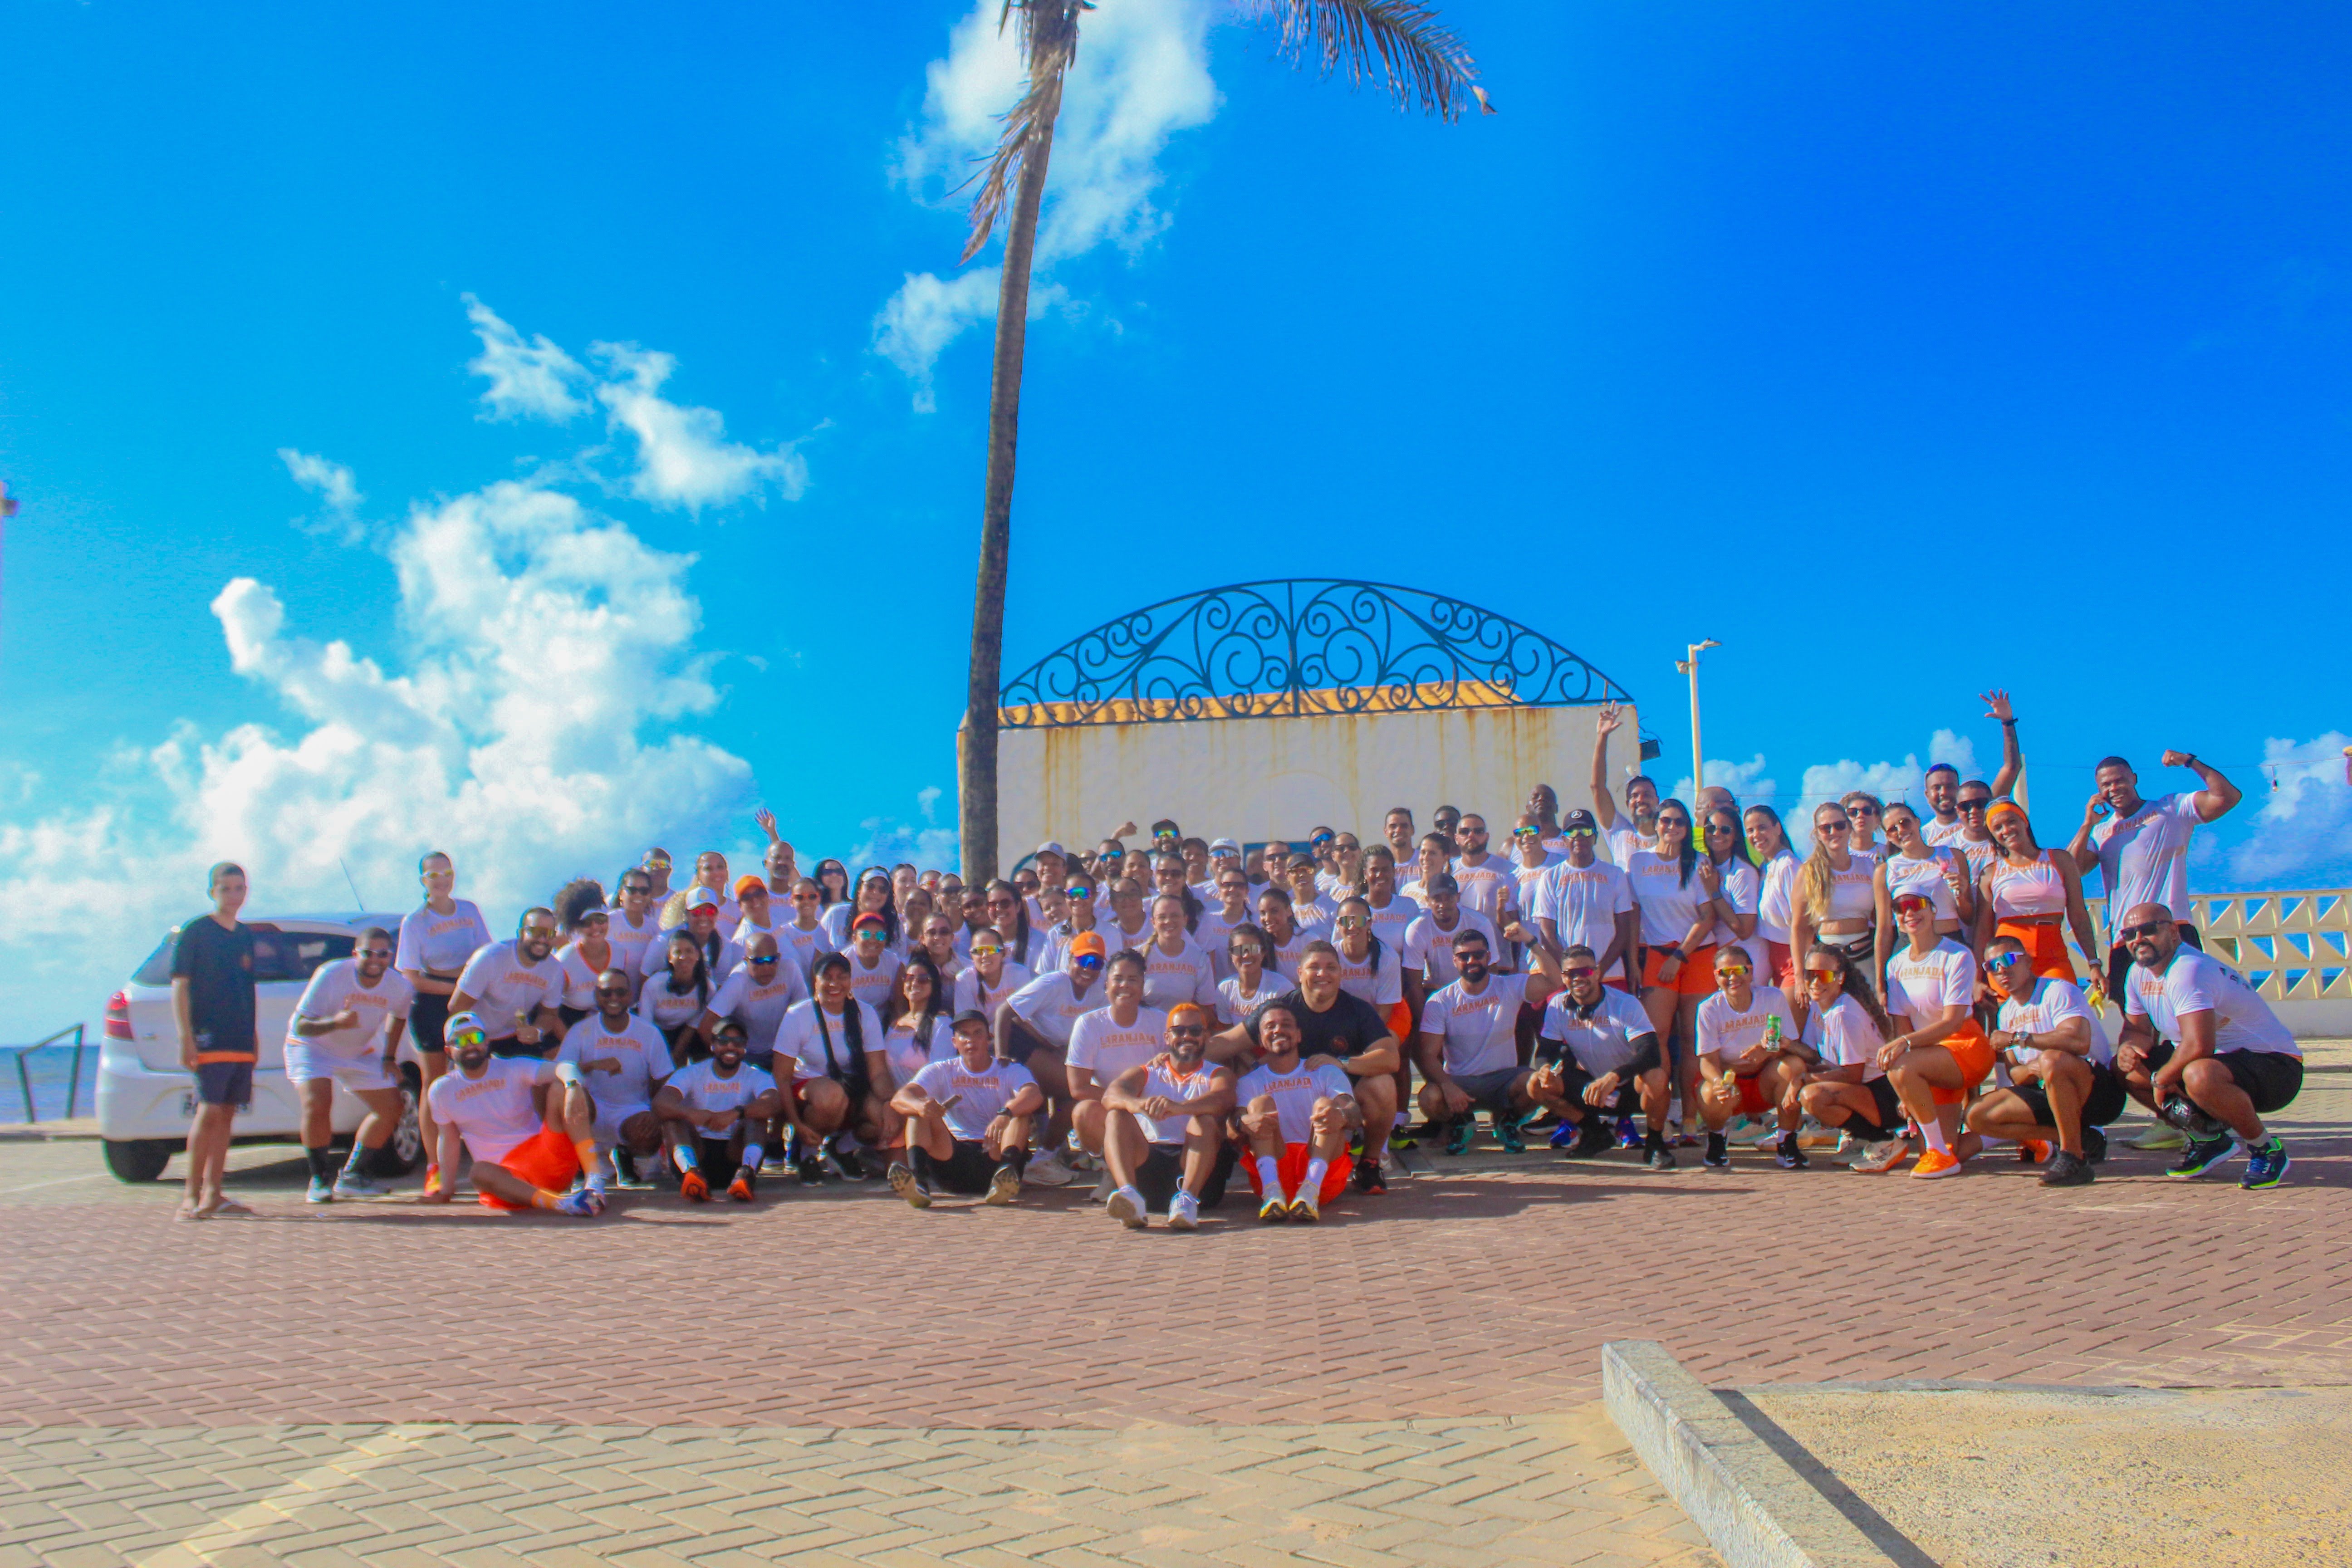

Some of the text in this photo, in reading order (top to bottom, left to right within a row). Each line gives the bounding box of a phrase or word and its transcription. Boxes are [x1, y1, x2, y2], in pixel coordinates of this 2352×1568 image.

[1454, 873, 1496, 881] ARANJADA
[1900, 967, 1944, 977] RANJADA
[1452, 997, 1499, 1014] LARANJADA
[1720, 1013, 1769, 1032] LARANJAD
